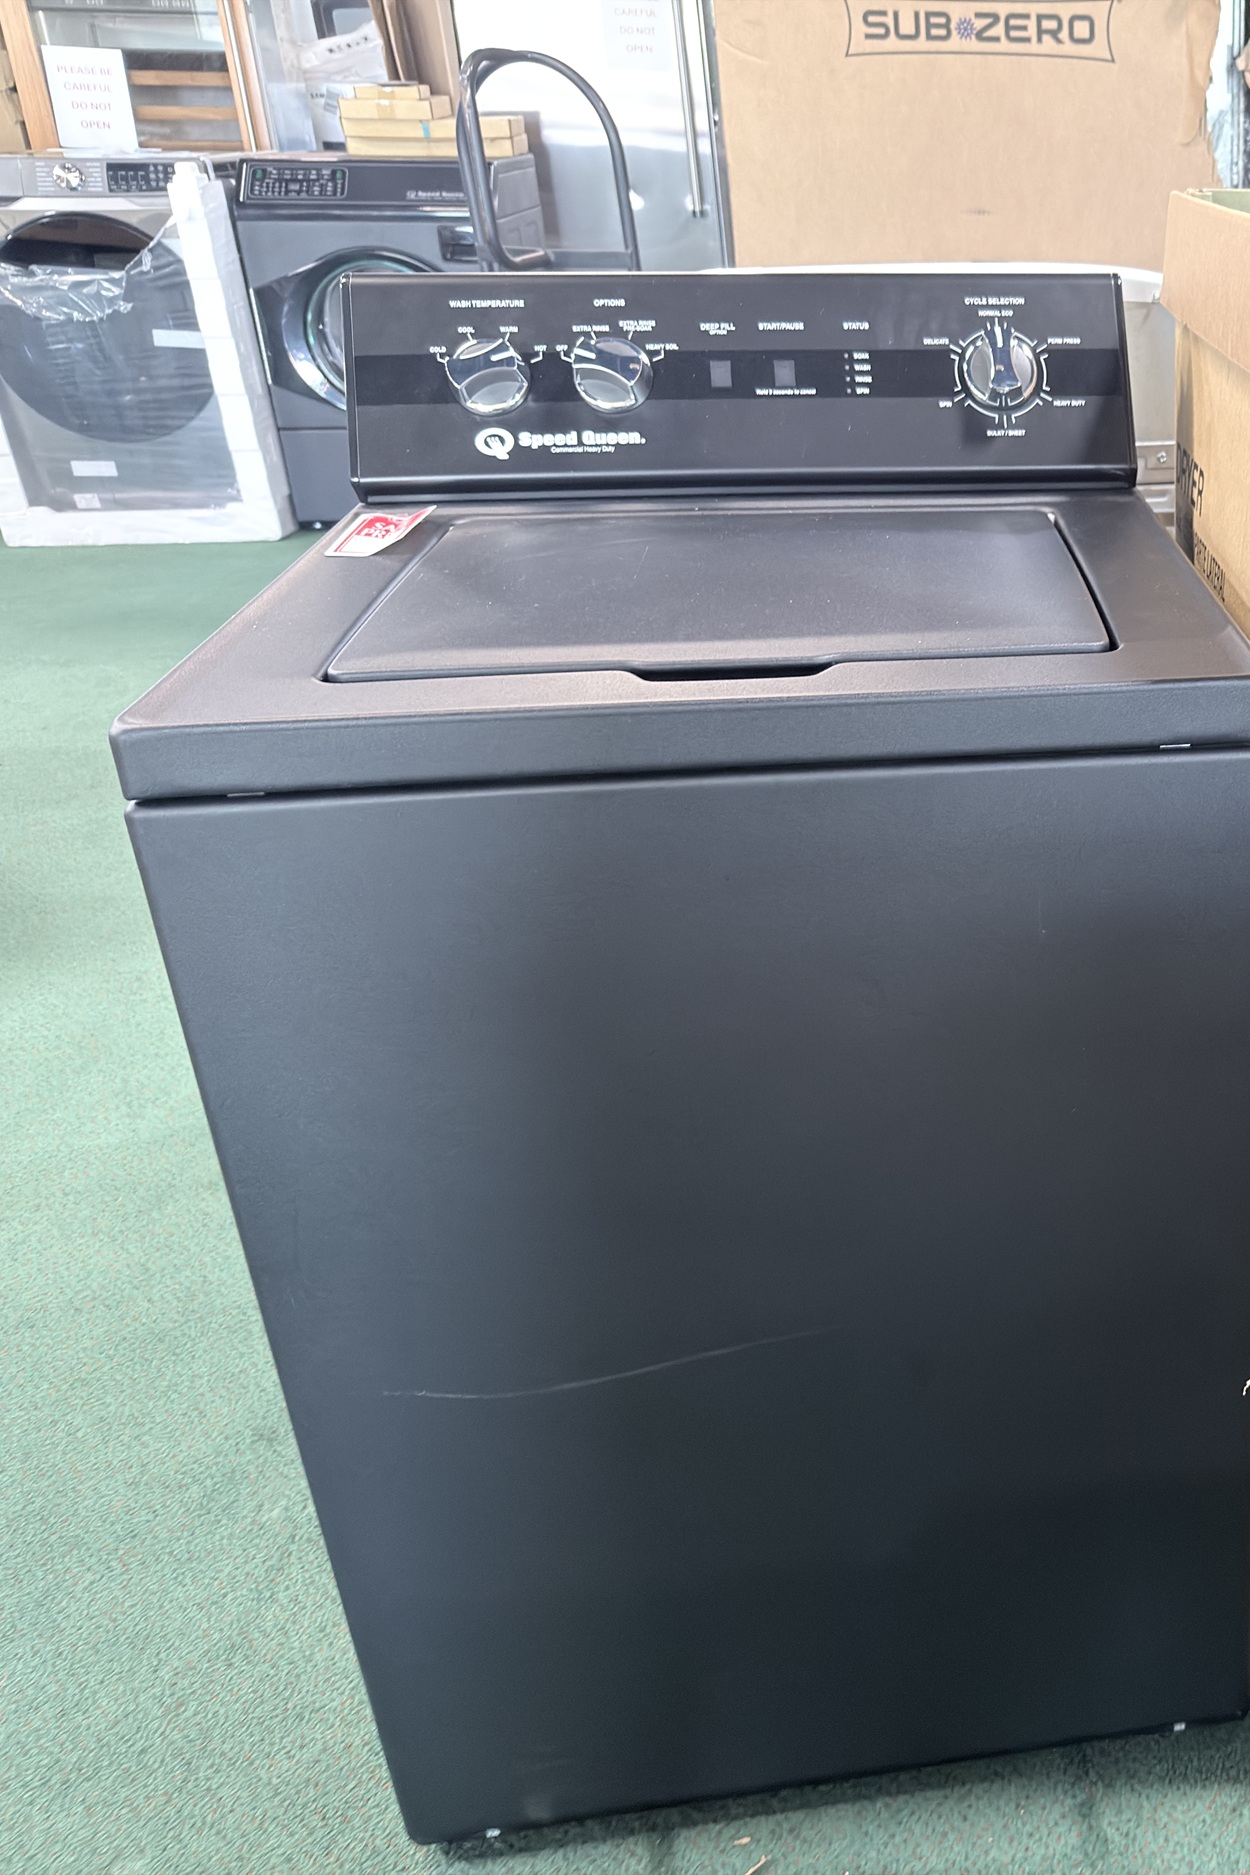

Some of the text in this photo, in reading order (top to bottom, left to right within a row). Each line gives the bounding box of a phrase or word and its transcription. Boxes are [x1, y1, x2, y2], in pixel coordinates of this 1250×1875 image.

[863, 9, 1096, 45] SUB ZERO
[57, 64, 112, 76] PLEASE BE
[63, 82, 113, 93] CAREFUL
[71, 101, 112, 111] DO NOT
[81, 120, 111, 129] OPEN
[449, 299, 524, 308] WASH TEMPERATURE
[593, 299, 626, 307] OPTIONS
[964, 297, 1025, 305] CYCLE SELECTION
[700, 322, 735, 331] DEEP FILL
[757, 322, 804, 330] START/PAUSE
[843, 322, 869, 330] STATUS
[518, 431, 578, 449] Speed
[551, 445, 615, 454] Commercial Heavy Duty
[1176, 443, 1205, 517] DRYER
